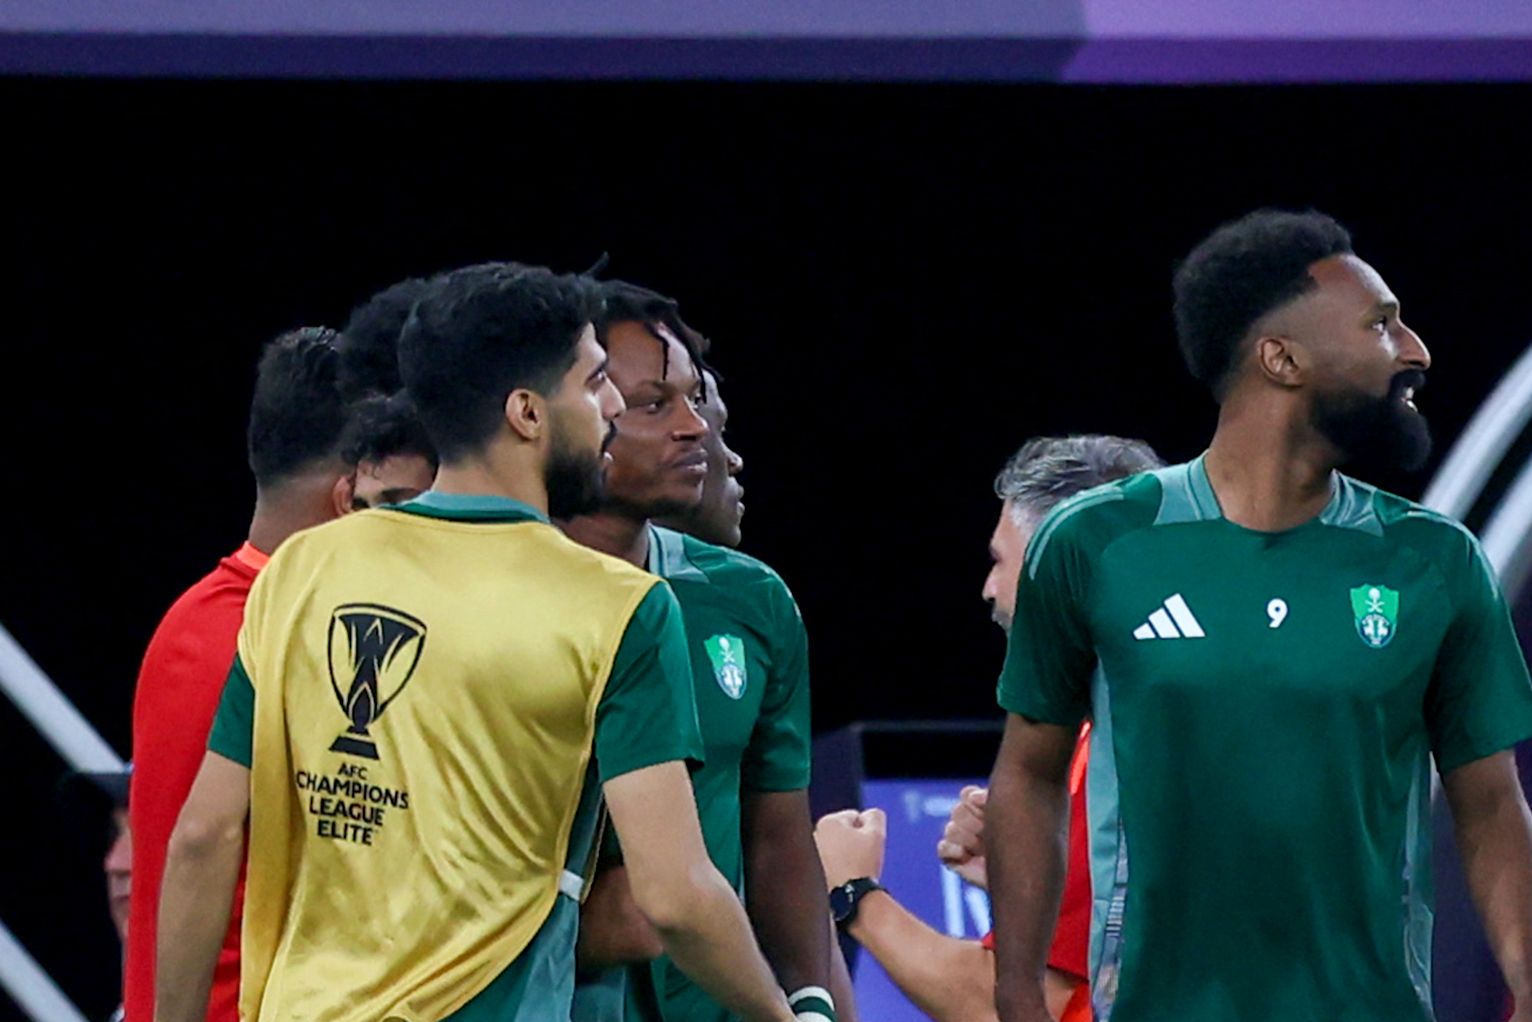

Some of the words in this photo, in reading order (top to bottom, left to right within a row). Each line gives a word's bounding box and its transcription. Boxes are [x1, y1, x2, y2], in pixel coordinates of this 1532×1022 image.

[1267, 598, 1288, 628] 9
[337, 762, 368, 781] AFC
[296, 771, 409, 810] CHAMPIONS
[309, 795, 385, 827] LEAGUE
[317, 820, 373, 846] ELITE
